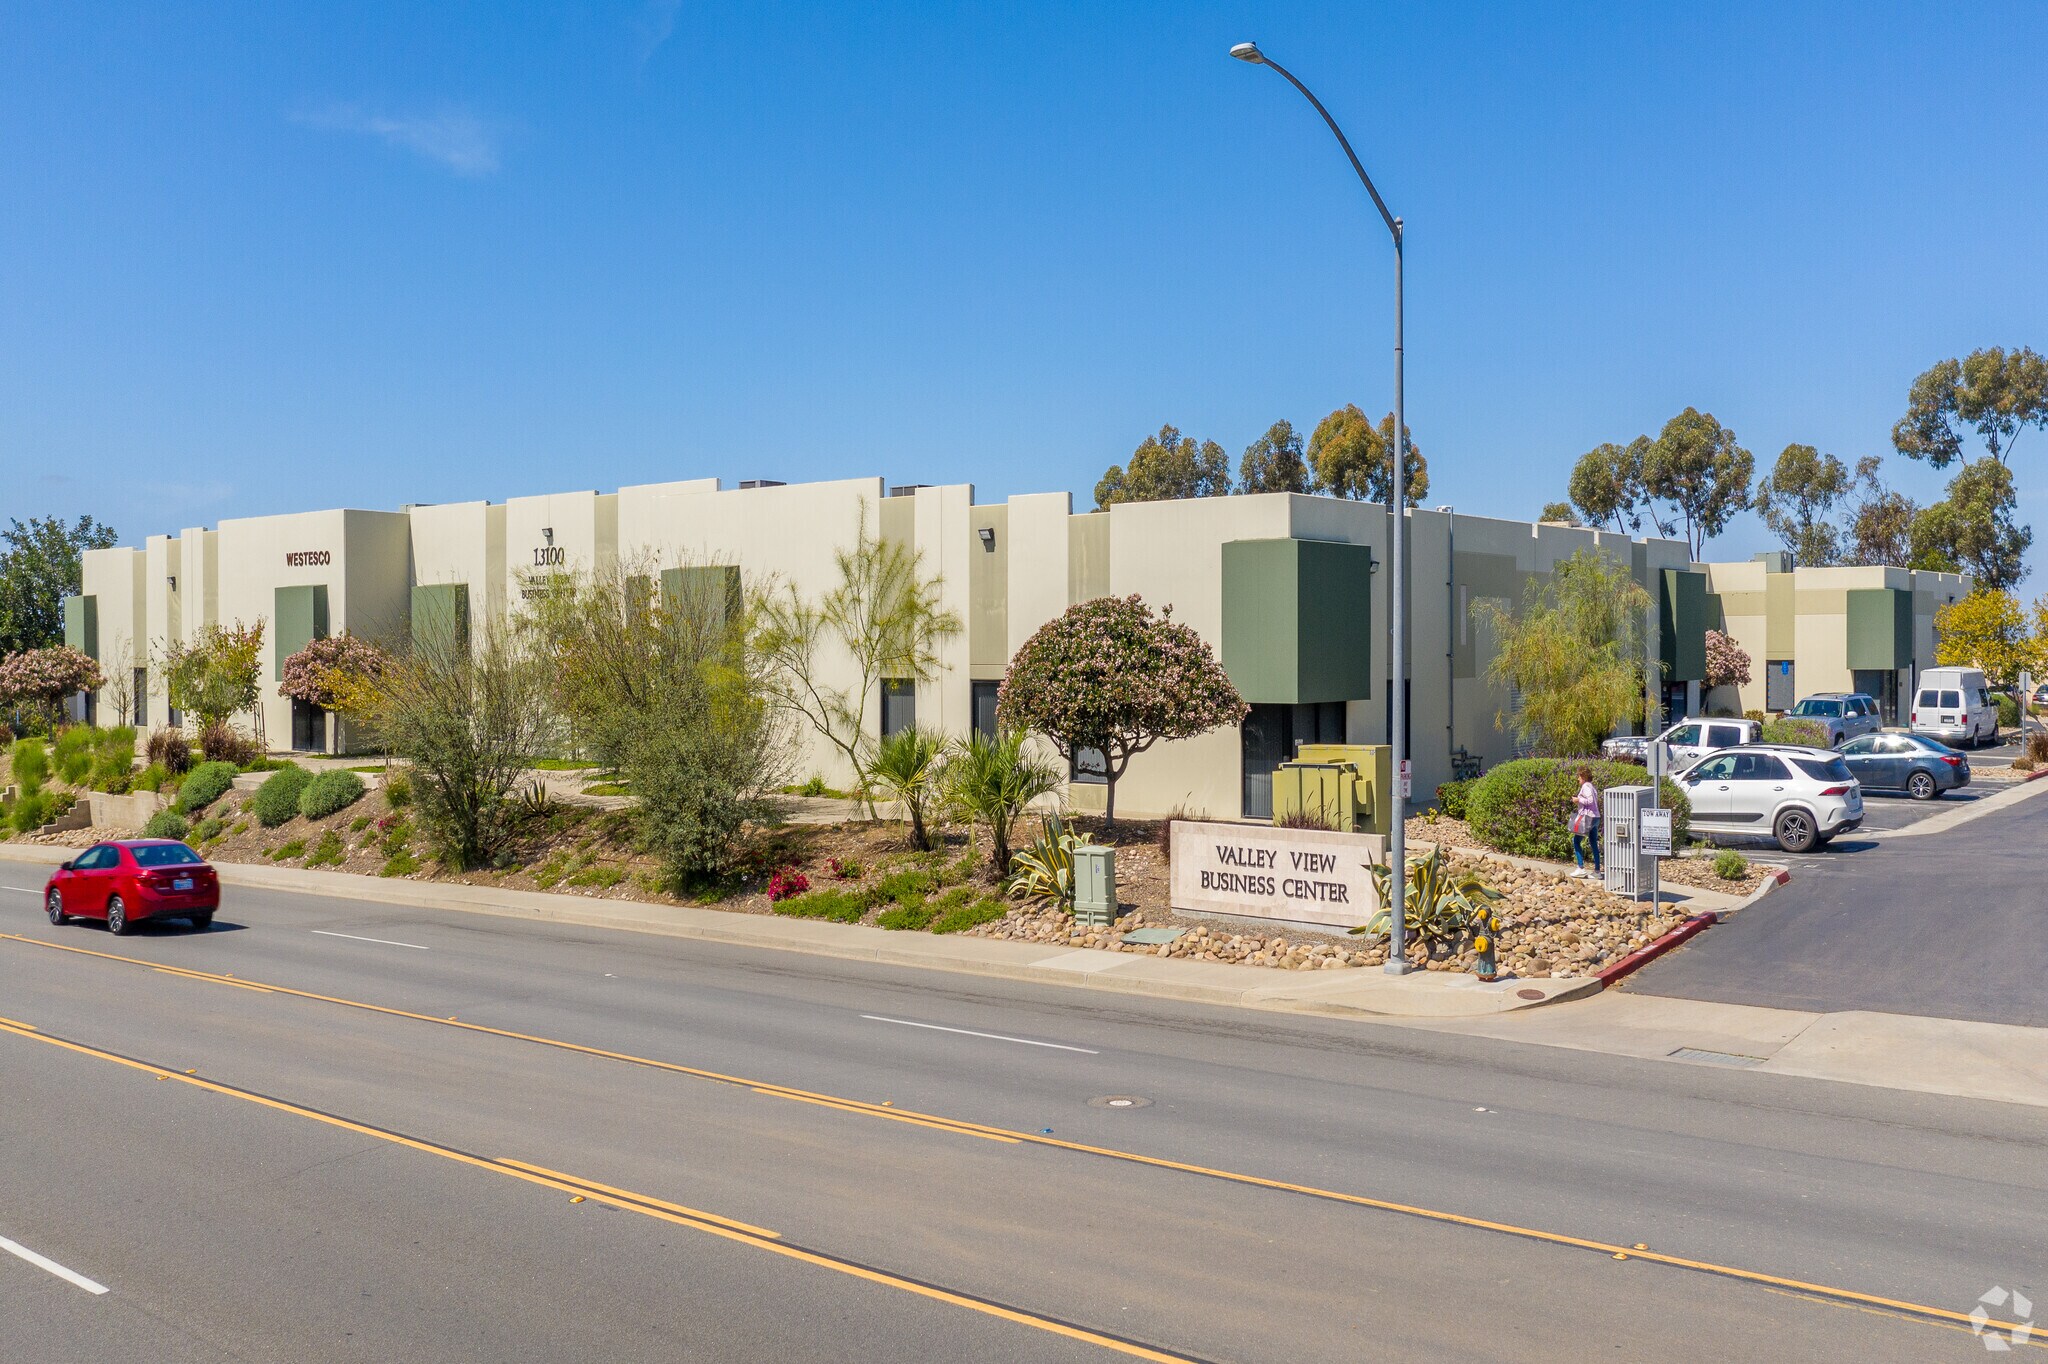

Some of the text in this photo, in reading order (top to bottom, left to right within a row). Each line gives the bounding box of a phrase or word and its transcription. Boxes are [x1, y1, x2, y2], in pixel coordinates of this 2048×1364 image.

[286, 550, 331, 567] WESTESCO
[533, 546, 565, 566] 13100
[1642, 809, 1669, 818] TOW AWAY
[1216, 845, 1336, 874] VALLEY VIEW
[1200, 870, 1349, 904] BUSINESS CENTER
